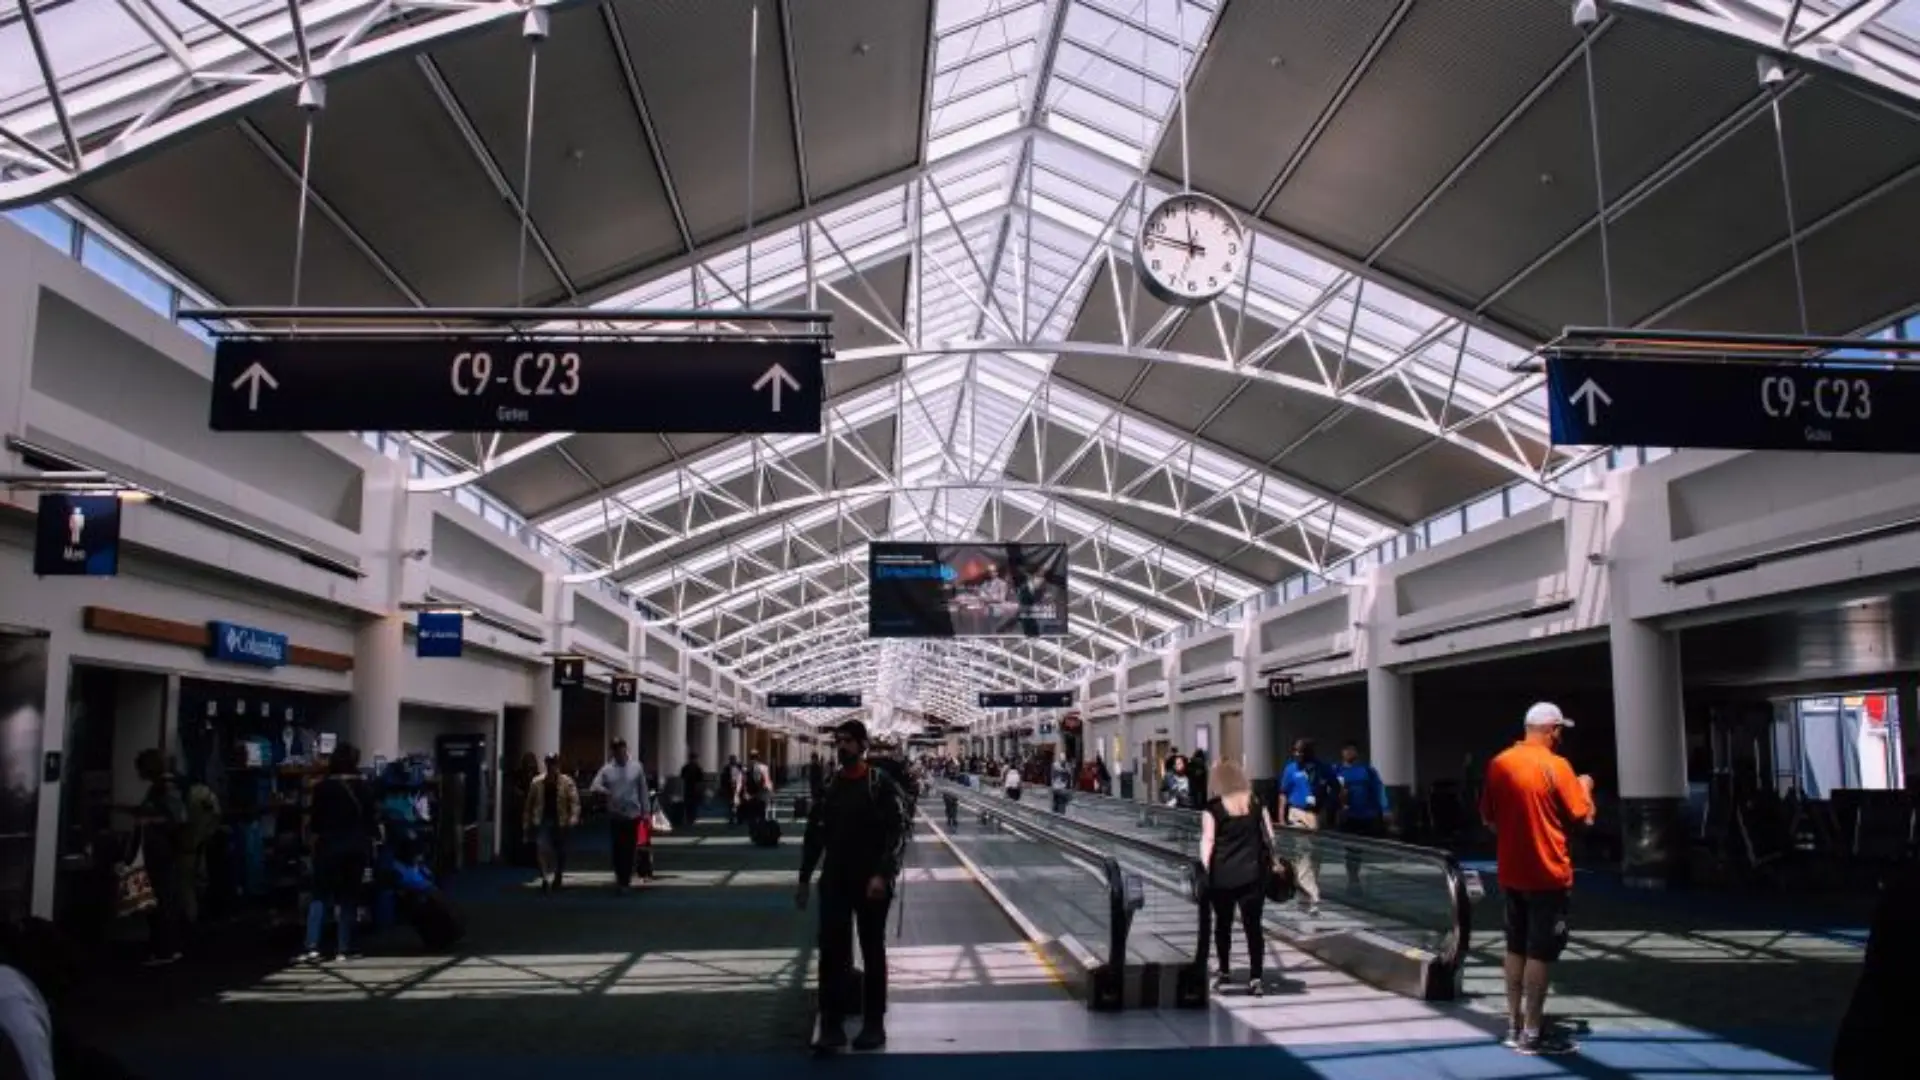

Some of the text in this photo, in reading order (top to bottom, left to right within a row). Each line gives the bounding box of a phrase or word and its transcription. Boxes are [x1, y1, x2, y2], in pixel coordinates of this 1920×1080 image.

[1222, 223, 1230, 235] 2
[1228, 242, 1237, 255] 3
[1151, 259, 1161, 271] 8
[1221, 261, 1232, 273] 4
[1168, 273, 1177, 286] 7
[1187, 280, 1198, 292] 6
[1208, 275, 1217, 287] 5
[450, 351, 581, 396] C9-C23
[1760, 376, 1872, 420] C9-C23
[496, 404, 530, 422] Gates
[63, 545, 87, 561] Men
[237, 629, 283, 660] Columbia
